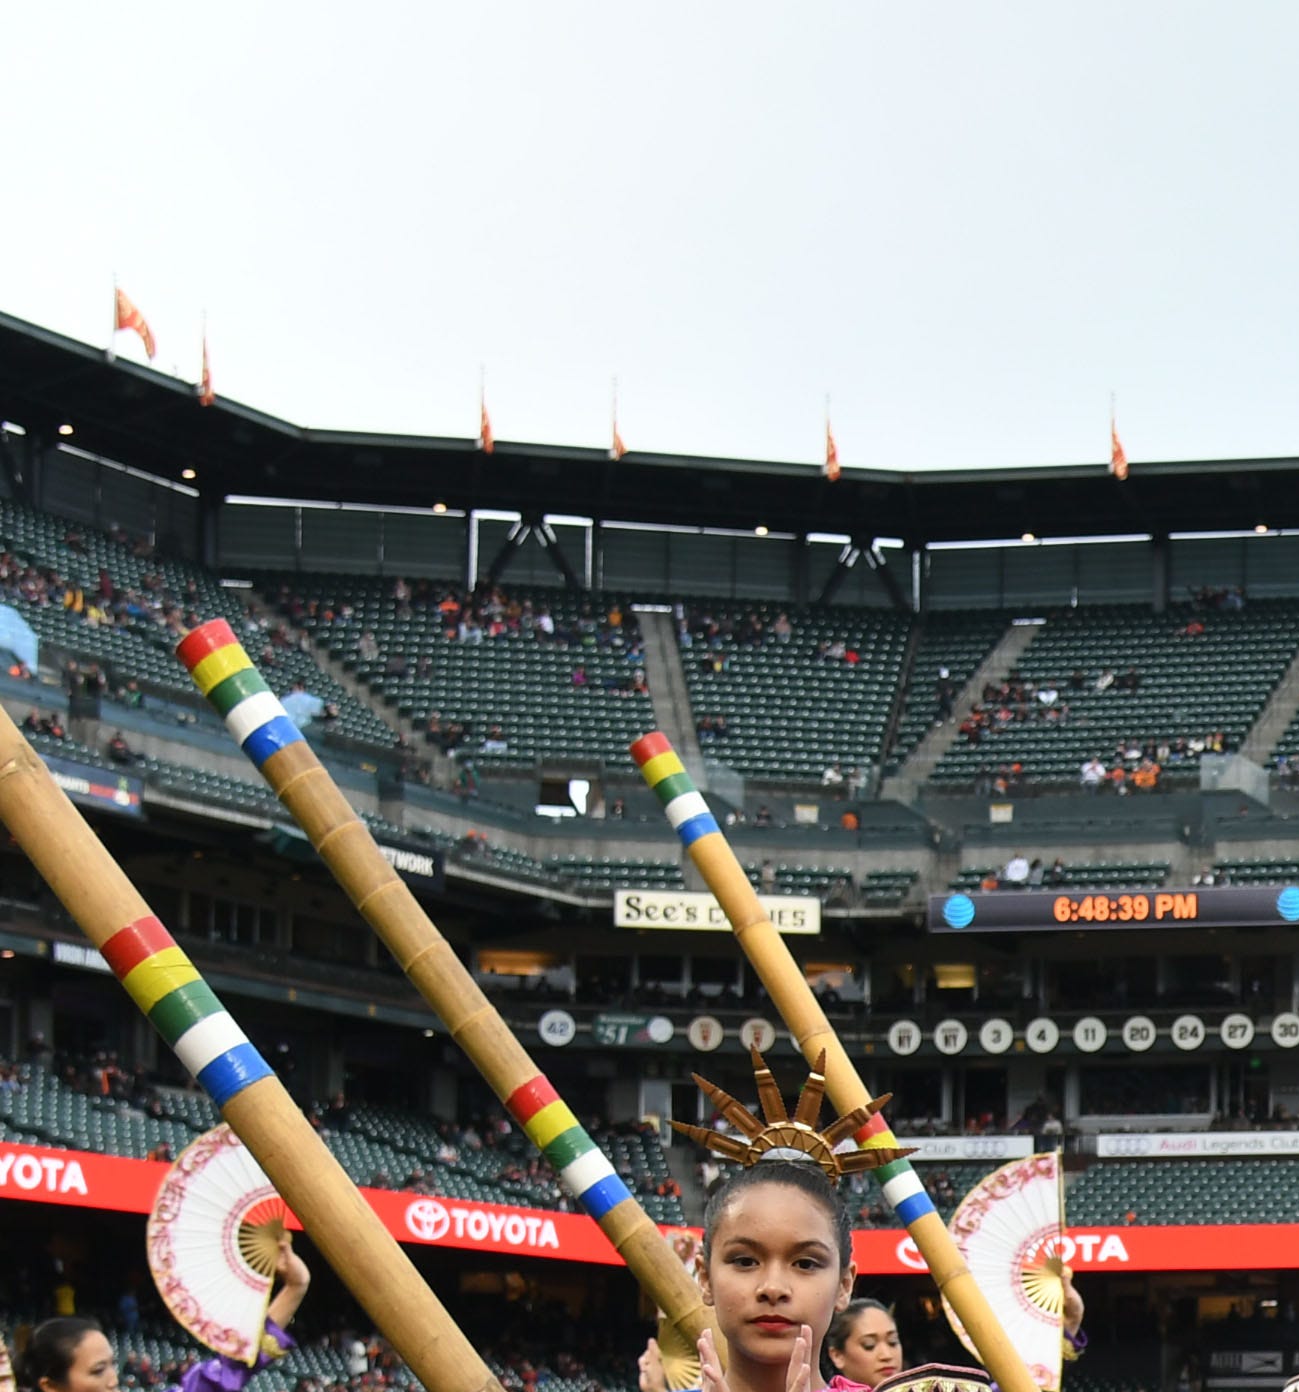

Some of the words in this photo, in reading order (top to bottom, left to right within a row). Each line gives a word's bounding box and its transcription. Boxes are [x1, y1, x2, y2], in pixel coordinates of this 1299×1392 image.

[624, 895, 698, 922] See's
[708, 907, 806, 927] CIES
[1053, 895, 1149, 922] 6:48:39
[1155, 893, 1197, 920] PM
[547, 1021, 569, 1037] 42
[1036, 1029, 1046, 1042] 4
[1083, 1028, 1096, 1041] 11
[1129, 1026, 1150, 1041] 20
[1177, 1025, 1199, 1040] 24
[1227, 1024, 1248, 1039] 27
[1278, 1023, 1299, 1038] 30
[992, 1030, 1002, 1044] 3
[1159, 1136, 1197, 1152] Audi
[1202, 1134, 1265, 1154] Legends
[451, 1207, 560, 1249] TOYOTA
